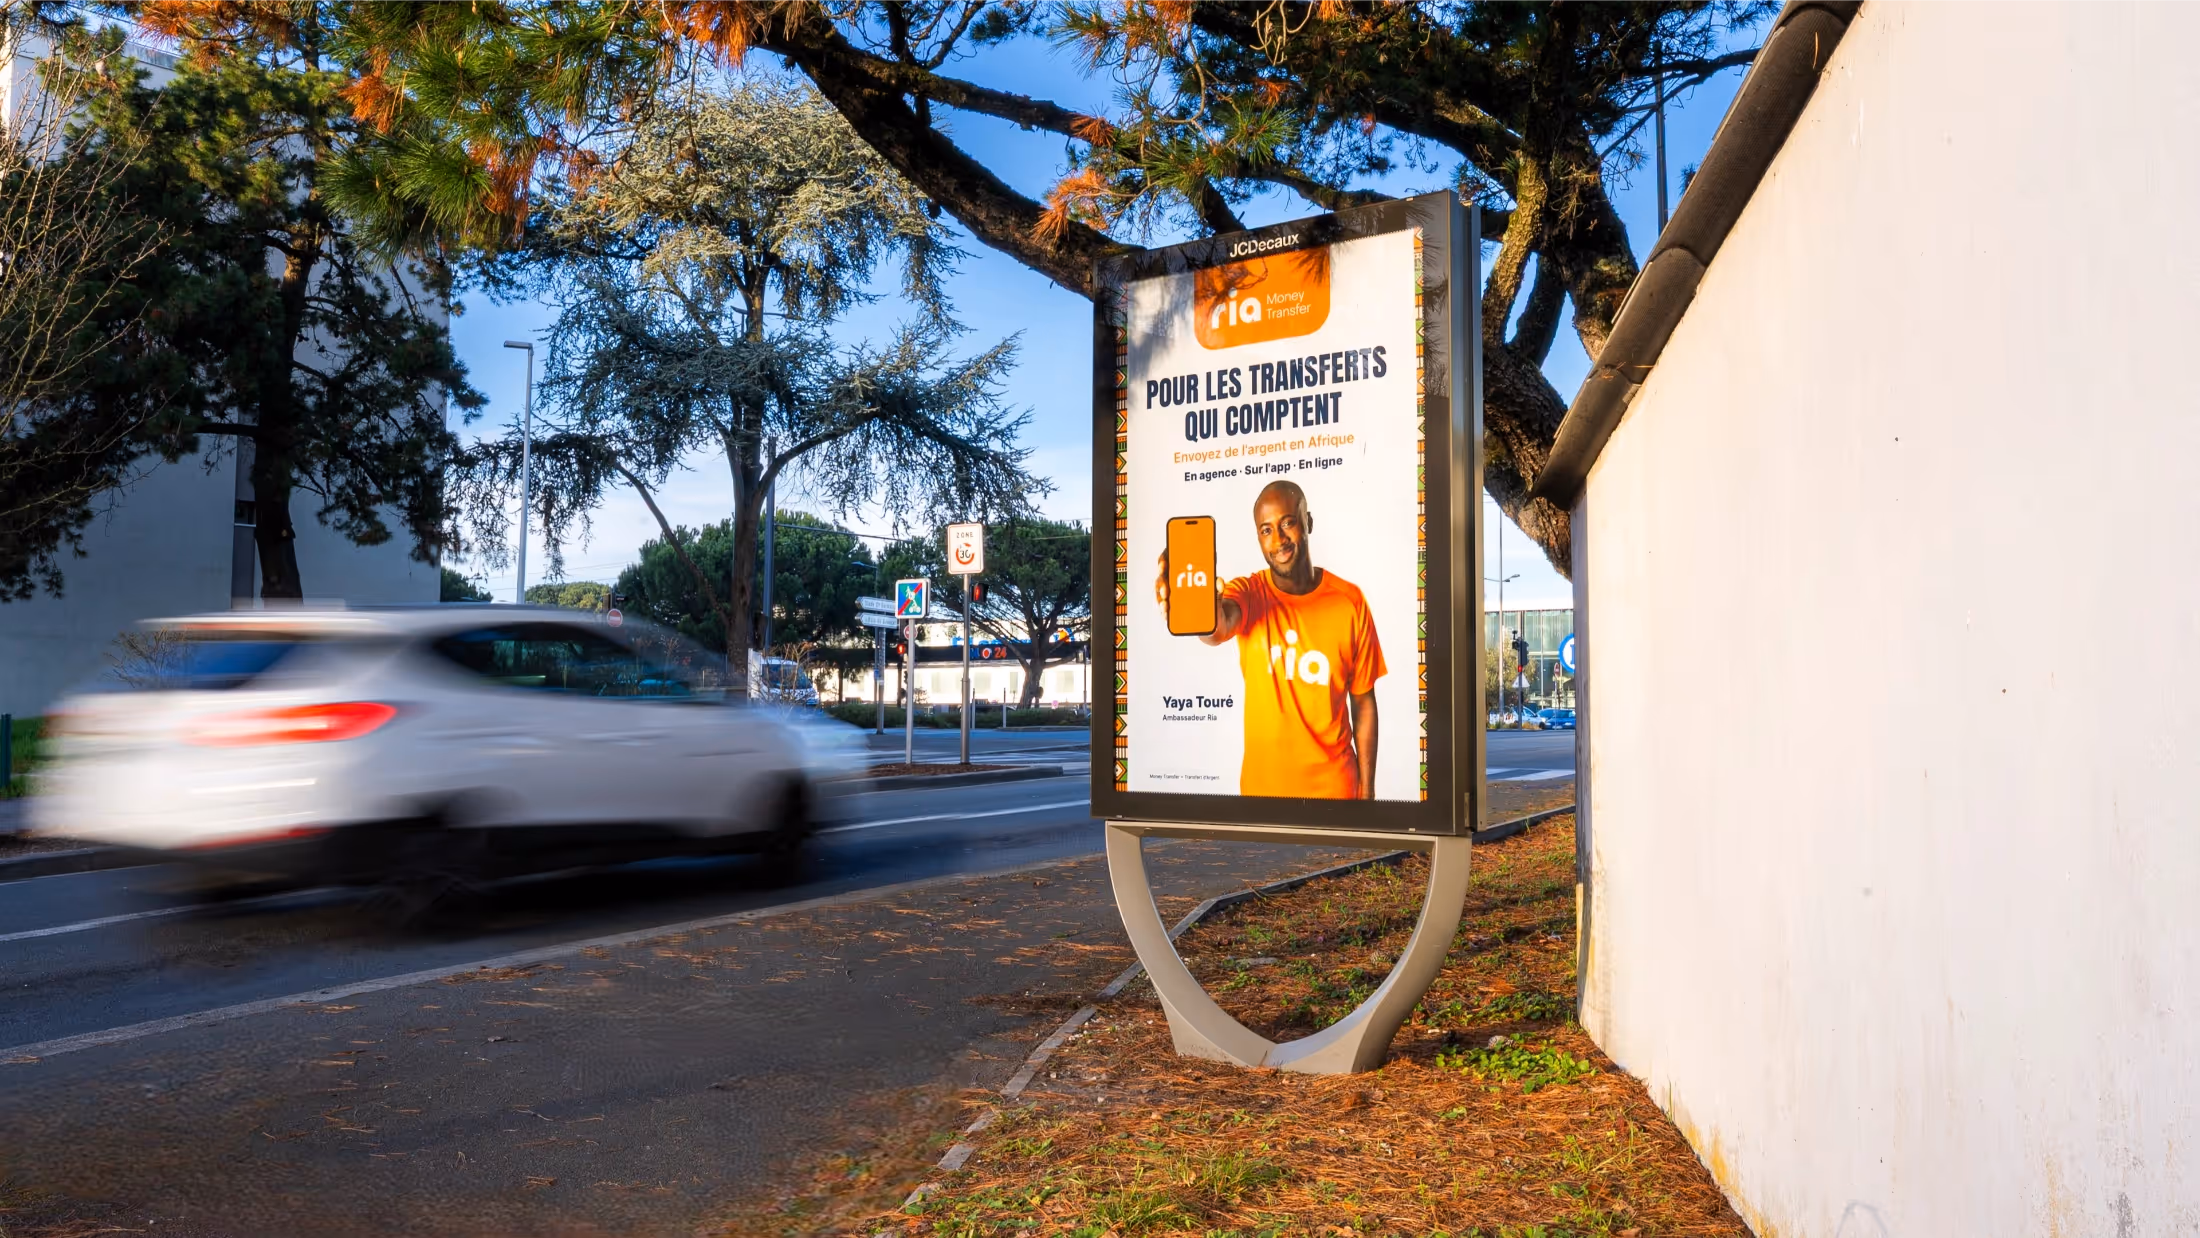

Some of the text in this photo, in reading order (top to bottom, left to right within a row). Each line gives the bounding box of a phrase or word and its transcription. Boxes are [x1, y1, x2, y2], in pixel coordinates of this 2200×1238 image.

[1229, 234, 1300, 258] JCDecaux
[1211, 287, 1262, 330] ria
[1266, 291, 1305, 305] Money
[1266, 303, 1311, 320] Transfer
[1146, 345, 1387, 410] POUR LES TRANSFERTS
[1185, 391, 1342, 443] QUI COMPTENT
[1173, 434, 1355, 464] Envoyez de l'argent en Afrique
[1184, 456, 1343, 483] En agence Sur l'app En ligne
[1176, 563, 1208, 588] ria
[994, 646, 1007, 658] 24
[1268, 629, 1331, 687] ria
[1162, 694, 1234, 711] Yaya Touré
